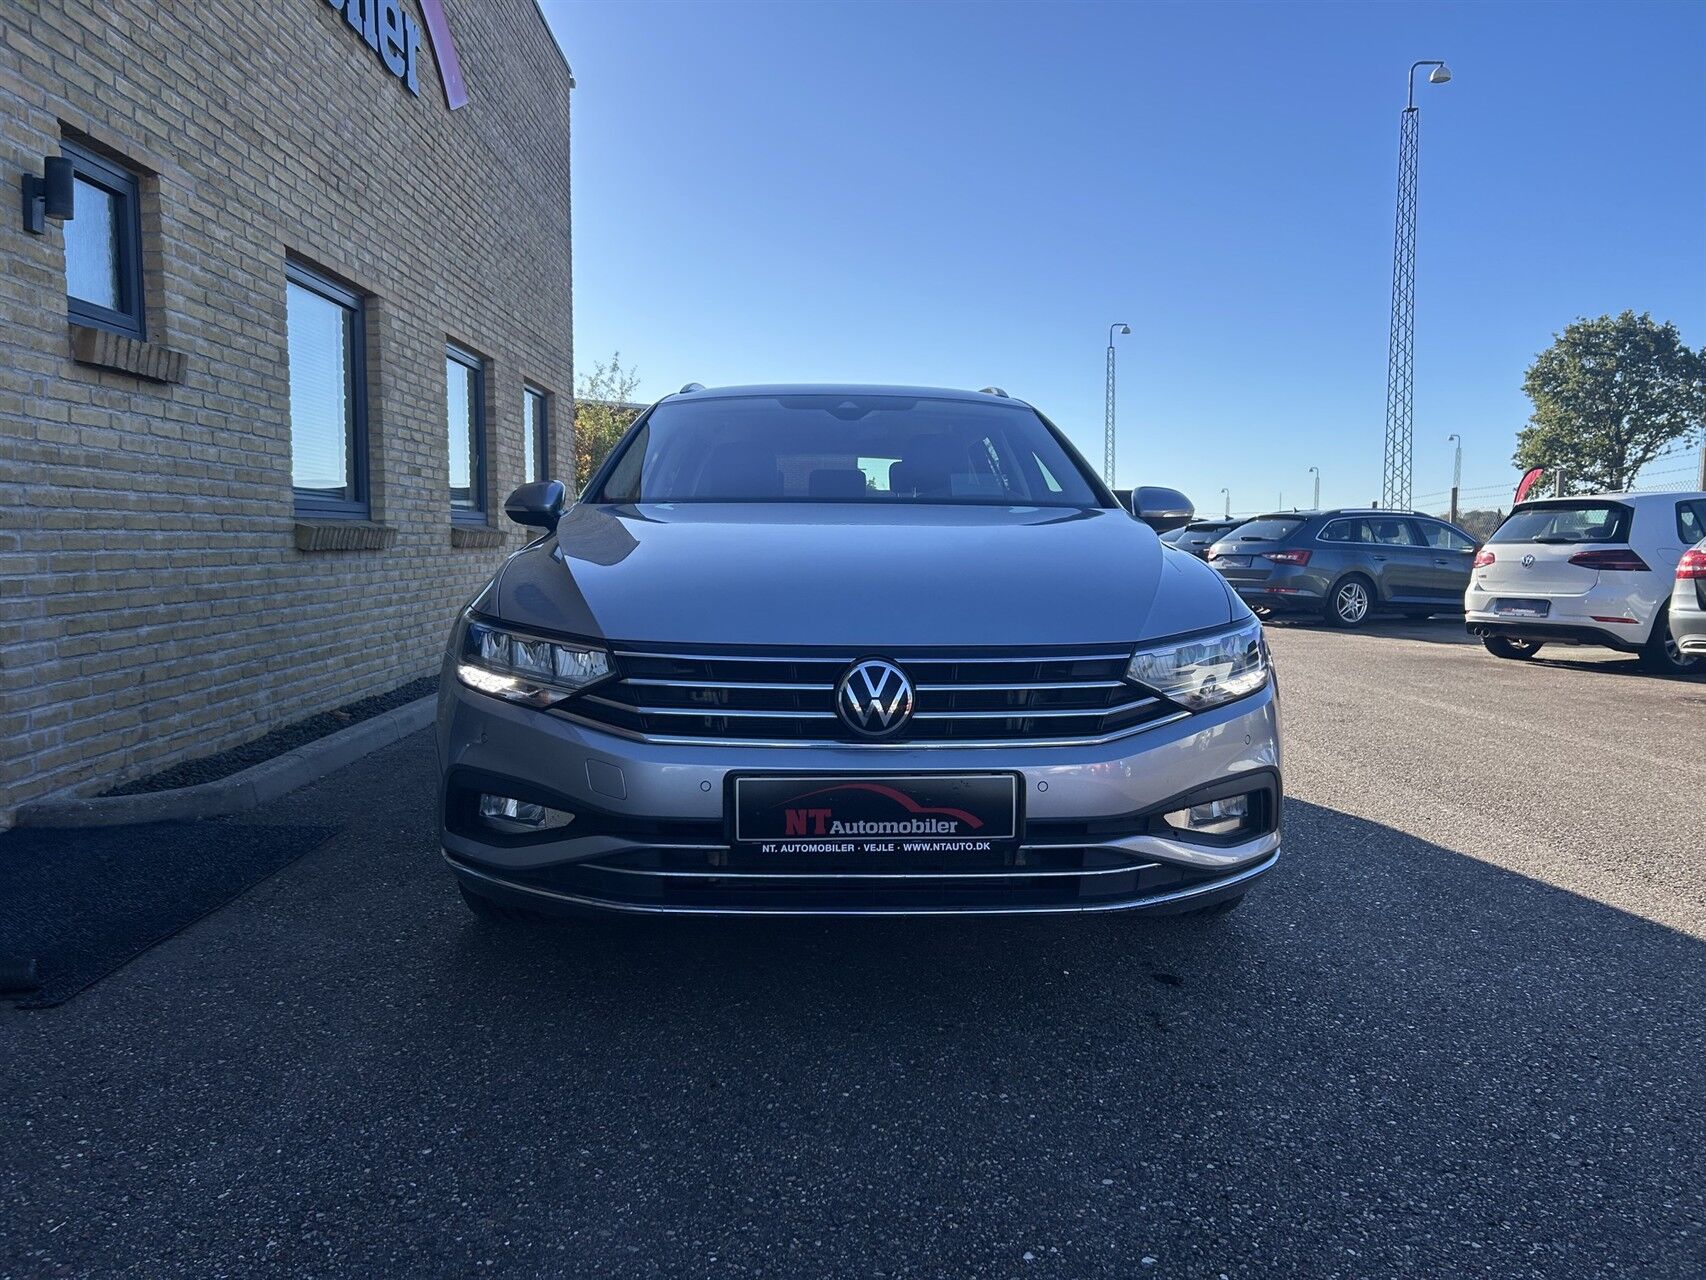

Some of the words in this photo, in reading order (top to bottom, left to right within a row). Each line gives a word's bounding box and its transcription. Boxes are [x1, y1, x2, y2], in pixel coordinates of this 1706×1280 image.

[785, 809, 831, 835] NT
[829, 819, 958, 834] Automobiler
[780, 843, 855, 853] AUTOMOBILER
[863, 843, 895, 852] VEJLE
[903, 842, 991, 852] WWW.NTAUTO.DK
